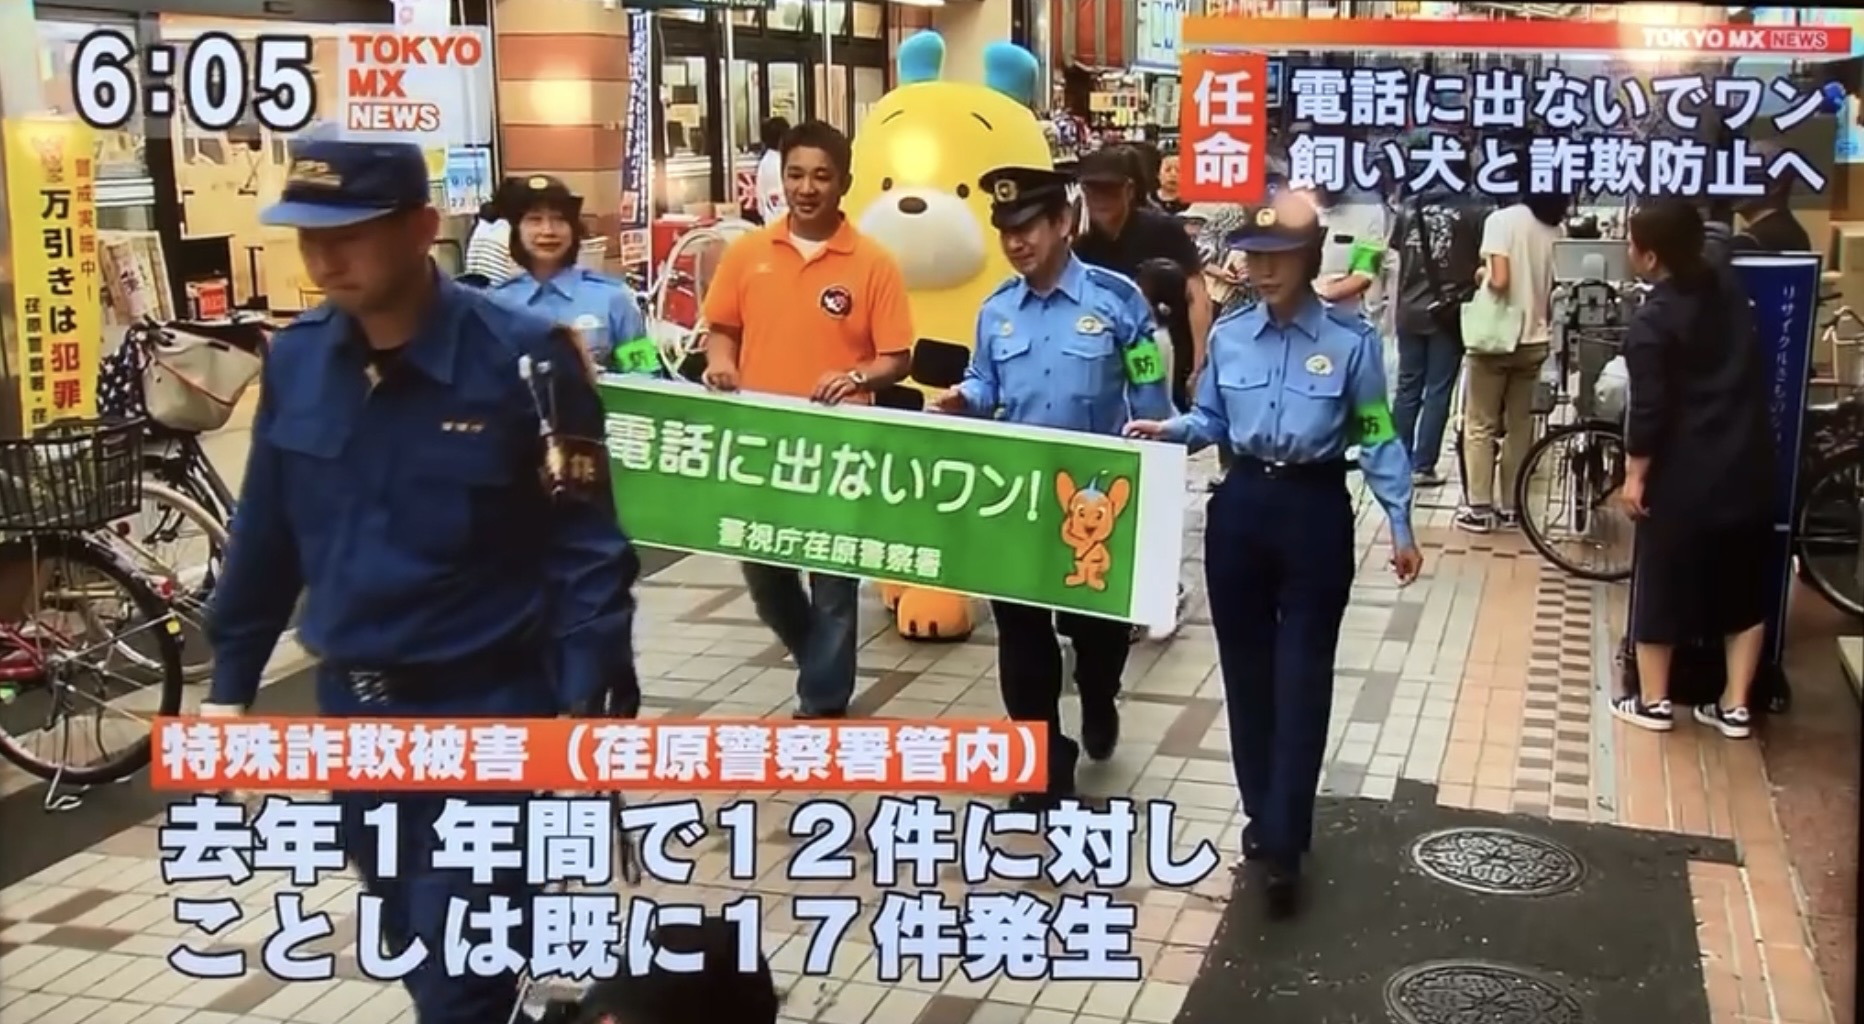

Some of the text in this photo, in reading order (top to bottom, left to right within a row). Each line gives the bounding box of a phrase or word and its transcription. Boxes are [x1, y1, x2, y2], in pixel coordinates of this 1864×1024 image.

[40, 188, 82, 409] 万引きは犯罪
[604, 412, 1042, 521] 電話に出ないワン!
[718, 517, 941, 577] 警視庁荏原警察署
